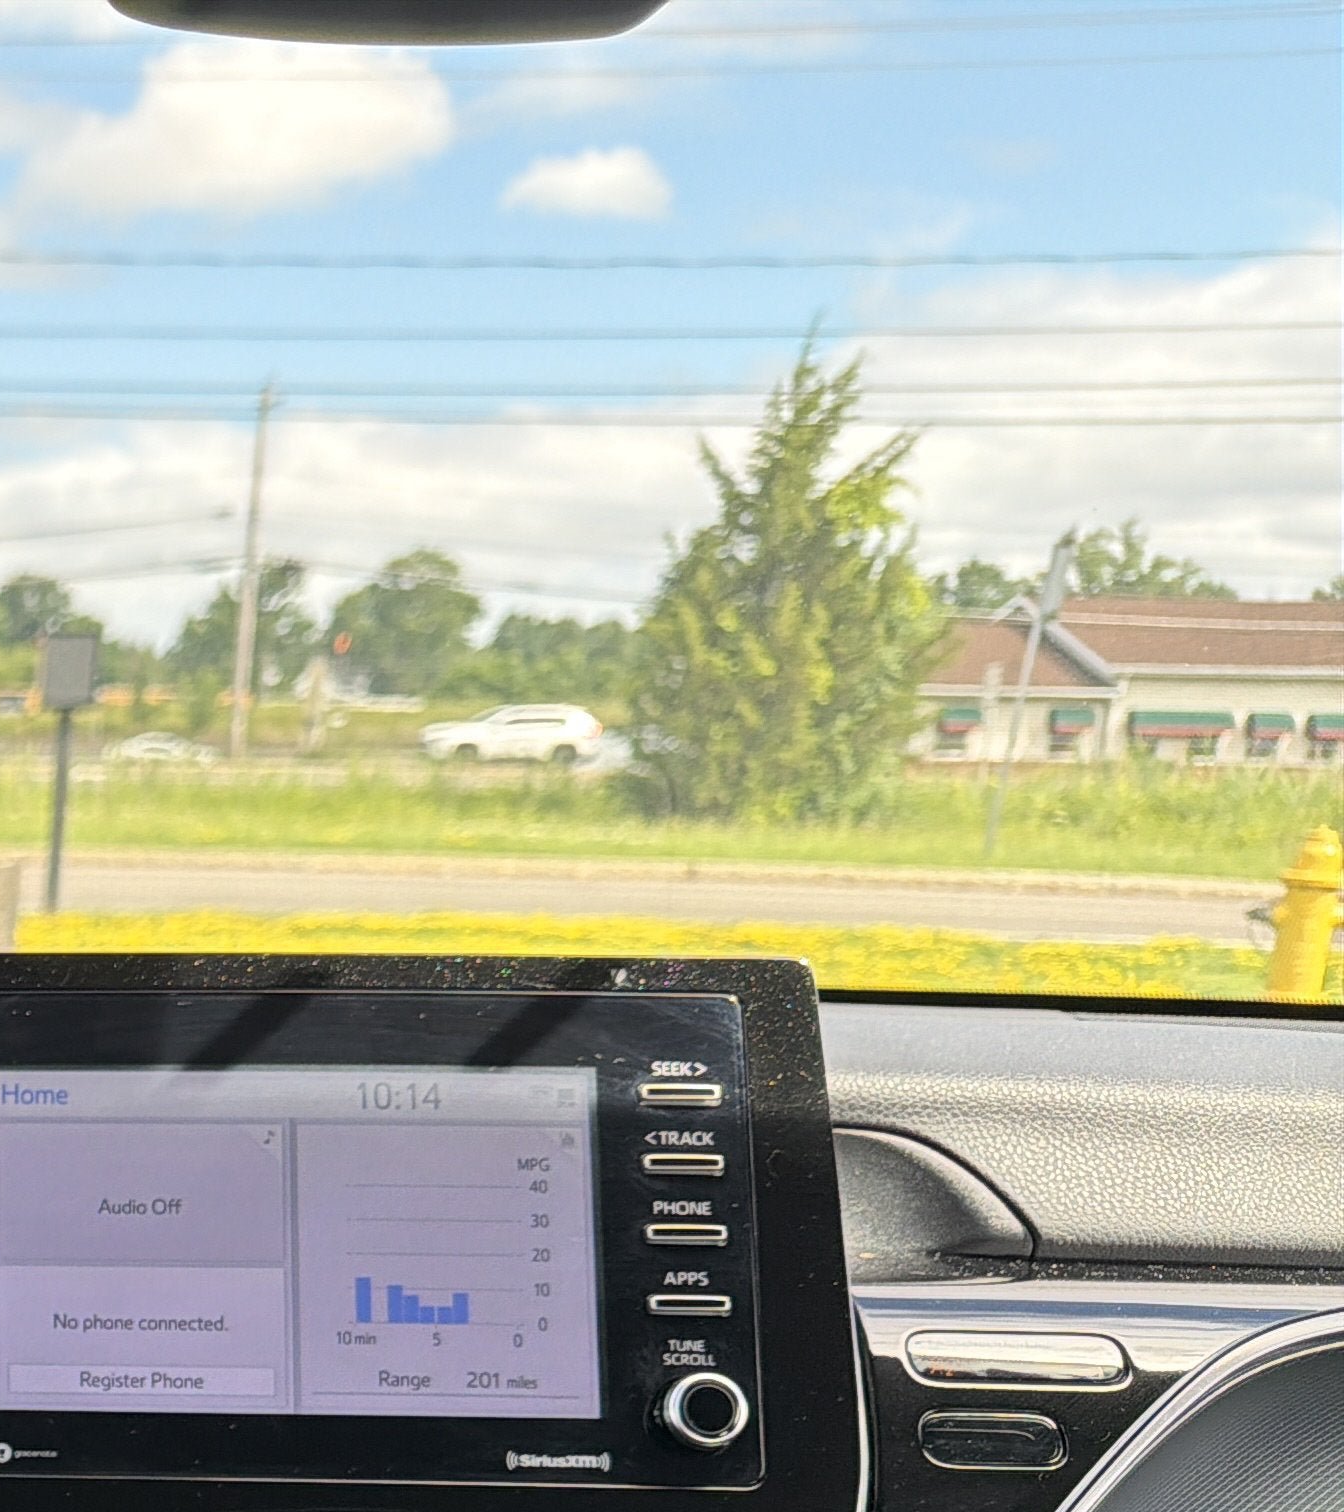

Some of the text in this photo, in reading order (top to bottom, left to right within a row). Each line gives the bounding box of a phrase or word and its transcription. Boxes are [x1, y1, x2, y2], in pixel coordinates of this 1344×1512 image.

[1, 1084, 69, 1106] Home
[355, 1082, 443, 1111] 10:14
[517, 1158, 550, 1173] MPG
[529, 1180, 548, 1194] 40
[98, 1198, 182, 1216] Audio Off
[652, 1201, 712, 1216] PHONE
[530, 1214, 549, 1229] 30
[531, 1248, 551, 1263] 20
[663, 1271, 709, 1287] APPS
[534, 1283, 550, 1298] 10
[53, 1313, 229, 1334] No phone connected.
[538, 1318, 548, 1332] 0
[336, 1331, 377, 1347] 10 min
[432, 1333, 441, 1347] 5
[513, 1334, 523, 1348] 0
[668, 1340, 706, 1353] TUNE
[662, 1352, 716, 1367] SCROLL
[79, 1372, 204, 1392] Register Phone
[378, 1371, 538, 1391] Range 201 miles
